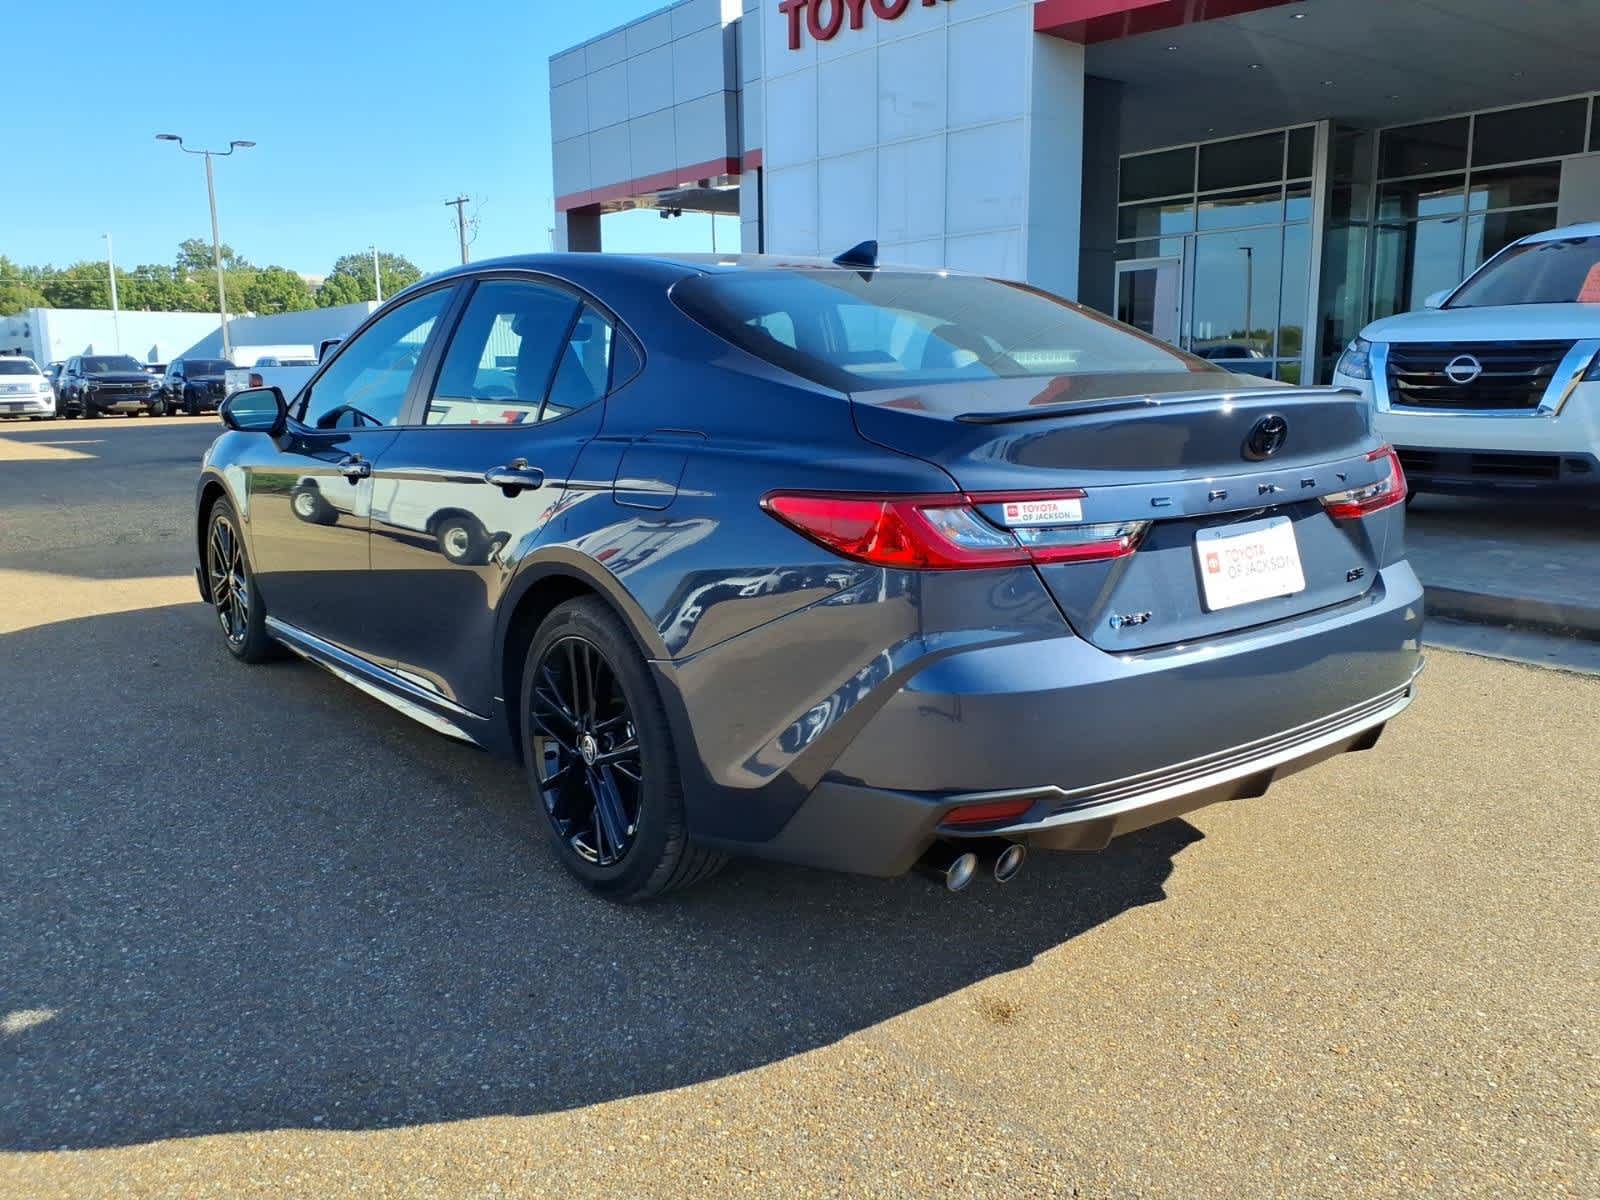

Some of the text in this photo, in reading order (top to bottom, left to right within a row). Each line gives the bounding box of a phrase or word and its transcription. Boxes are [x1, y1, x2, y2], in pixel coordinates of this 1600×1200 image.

[1022, 504, 1058, 513] TOYOTA
[1036, 512, 1071, 520] JACKSON
[1224, 544, 1265, 562] TOYOTA
[1228, 555, 1295, 579] OF JACKSON
